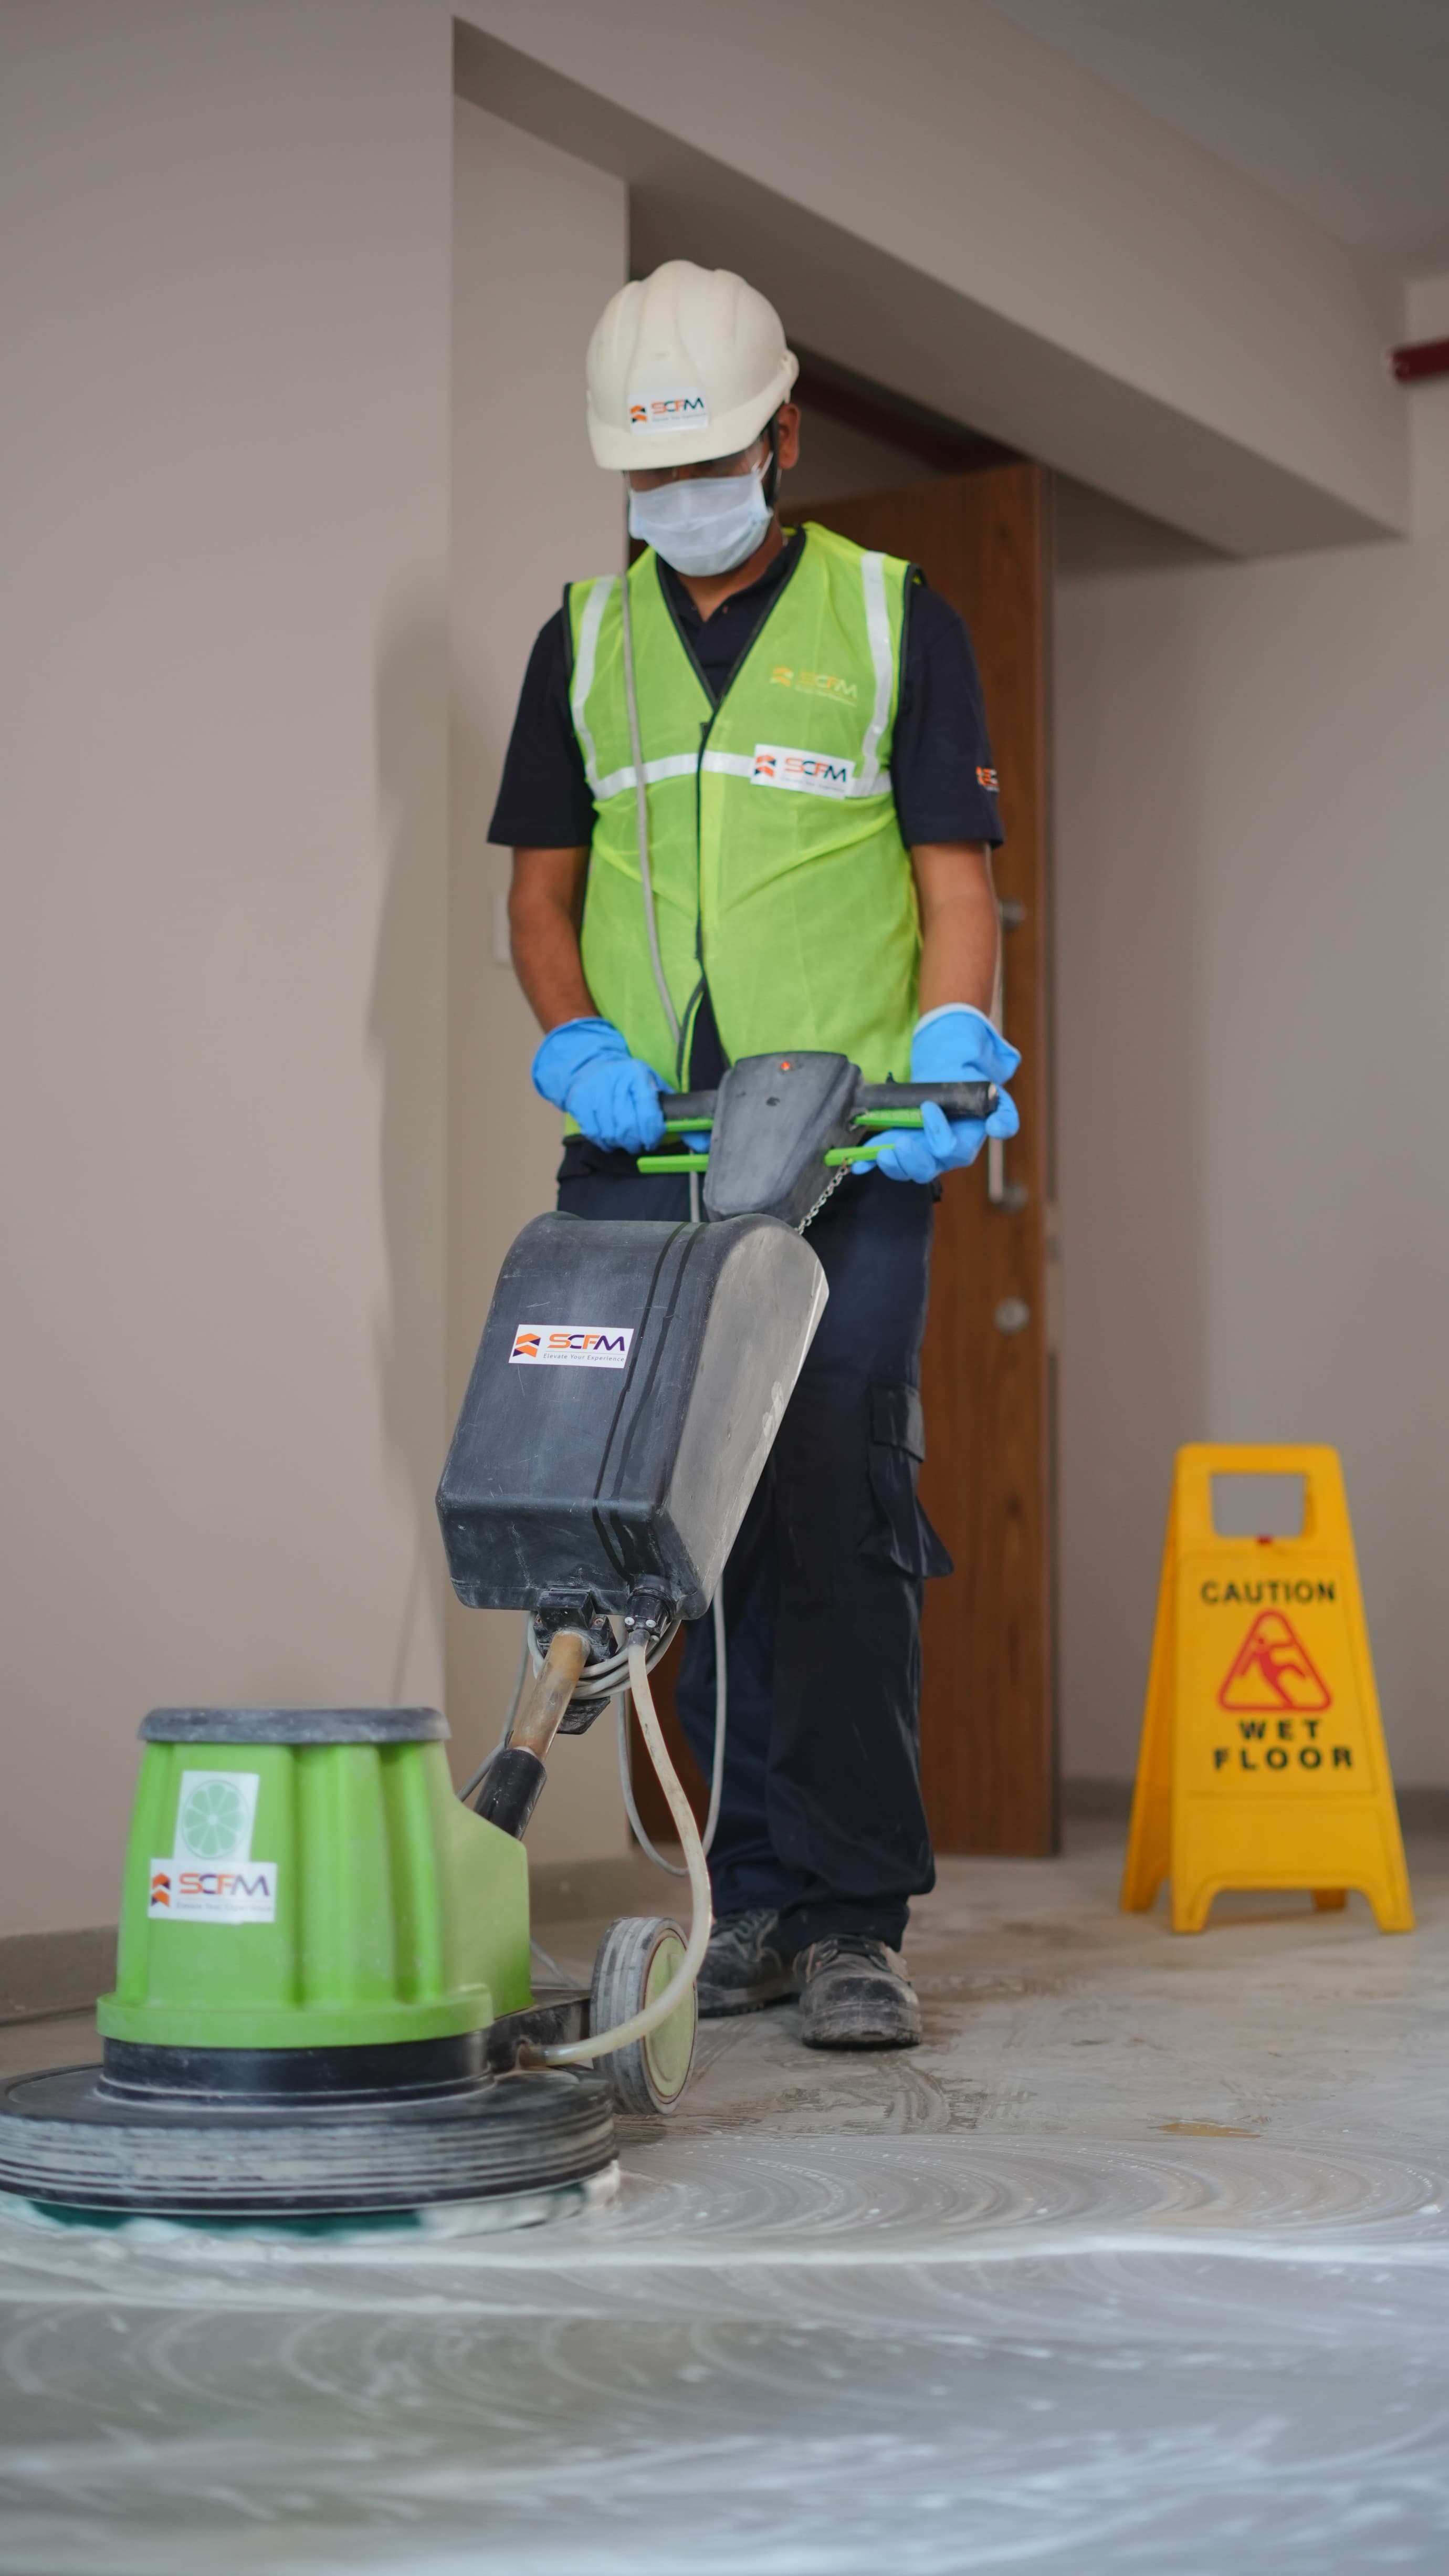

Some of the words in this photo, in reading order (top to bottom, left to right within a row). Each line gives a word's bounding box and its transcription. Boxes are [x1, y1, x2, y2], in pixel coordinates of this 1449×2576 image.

[651, 397, 704, 414] SCFM
[785, 757, 846, 783] SCFM
[547, 1333, 625, 1351] SCFM
[1201, 1581, 1336, 1603] CAUTION
[1240, 1720, 1320, 1740] WET
[1213, 1747, 1352, 1770] FLOOR
[178, 1873, 270, 1897] SCFM
